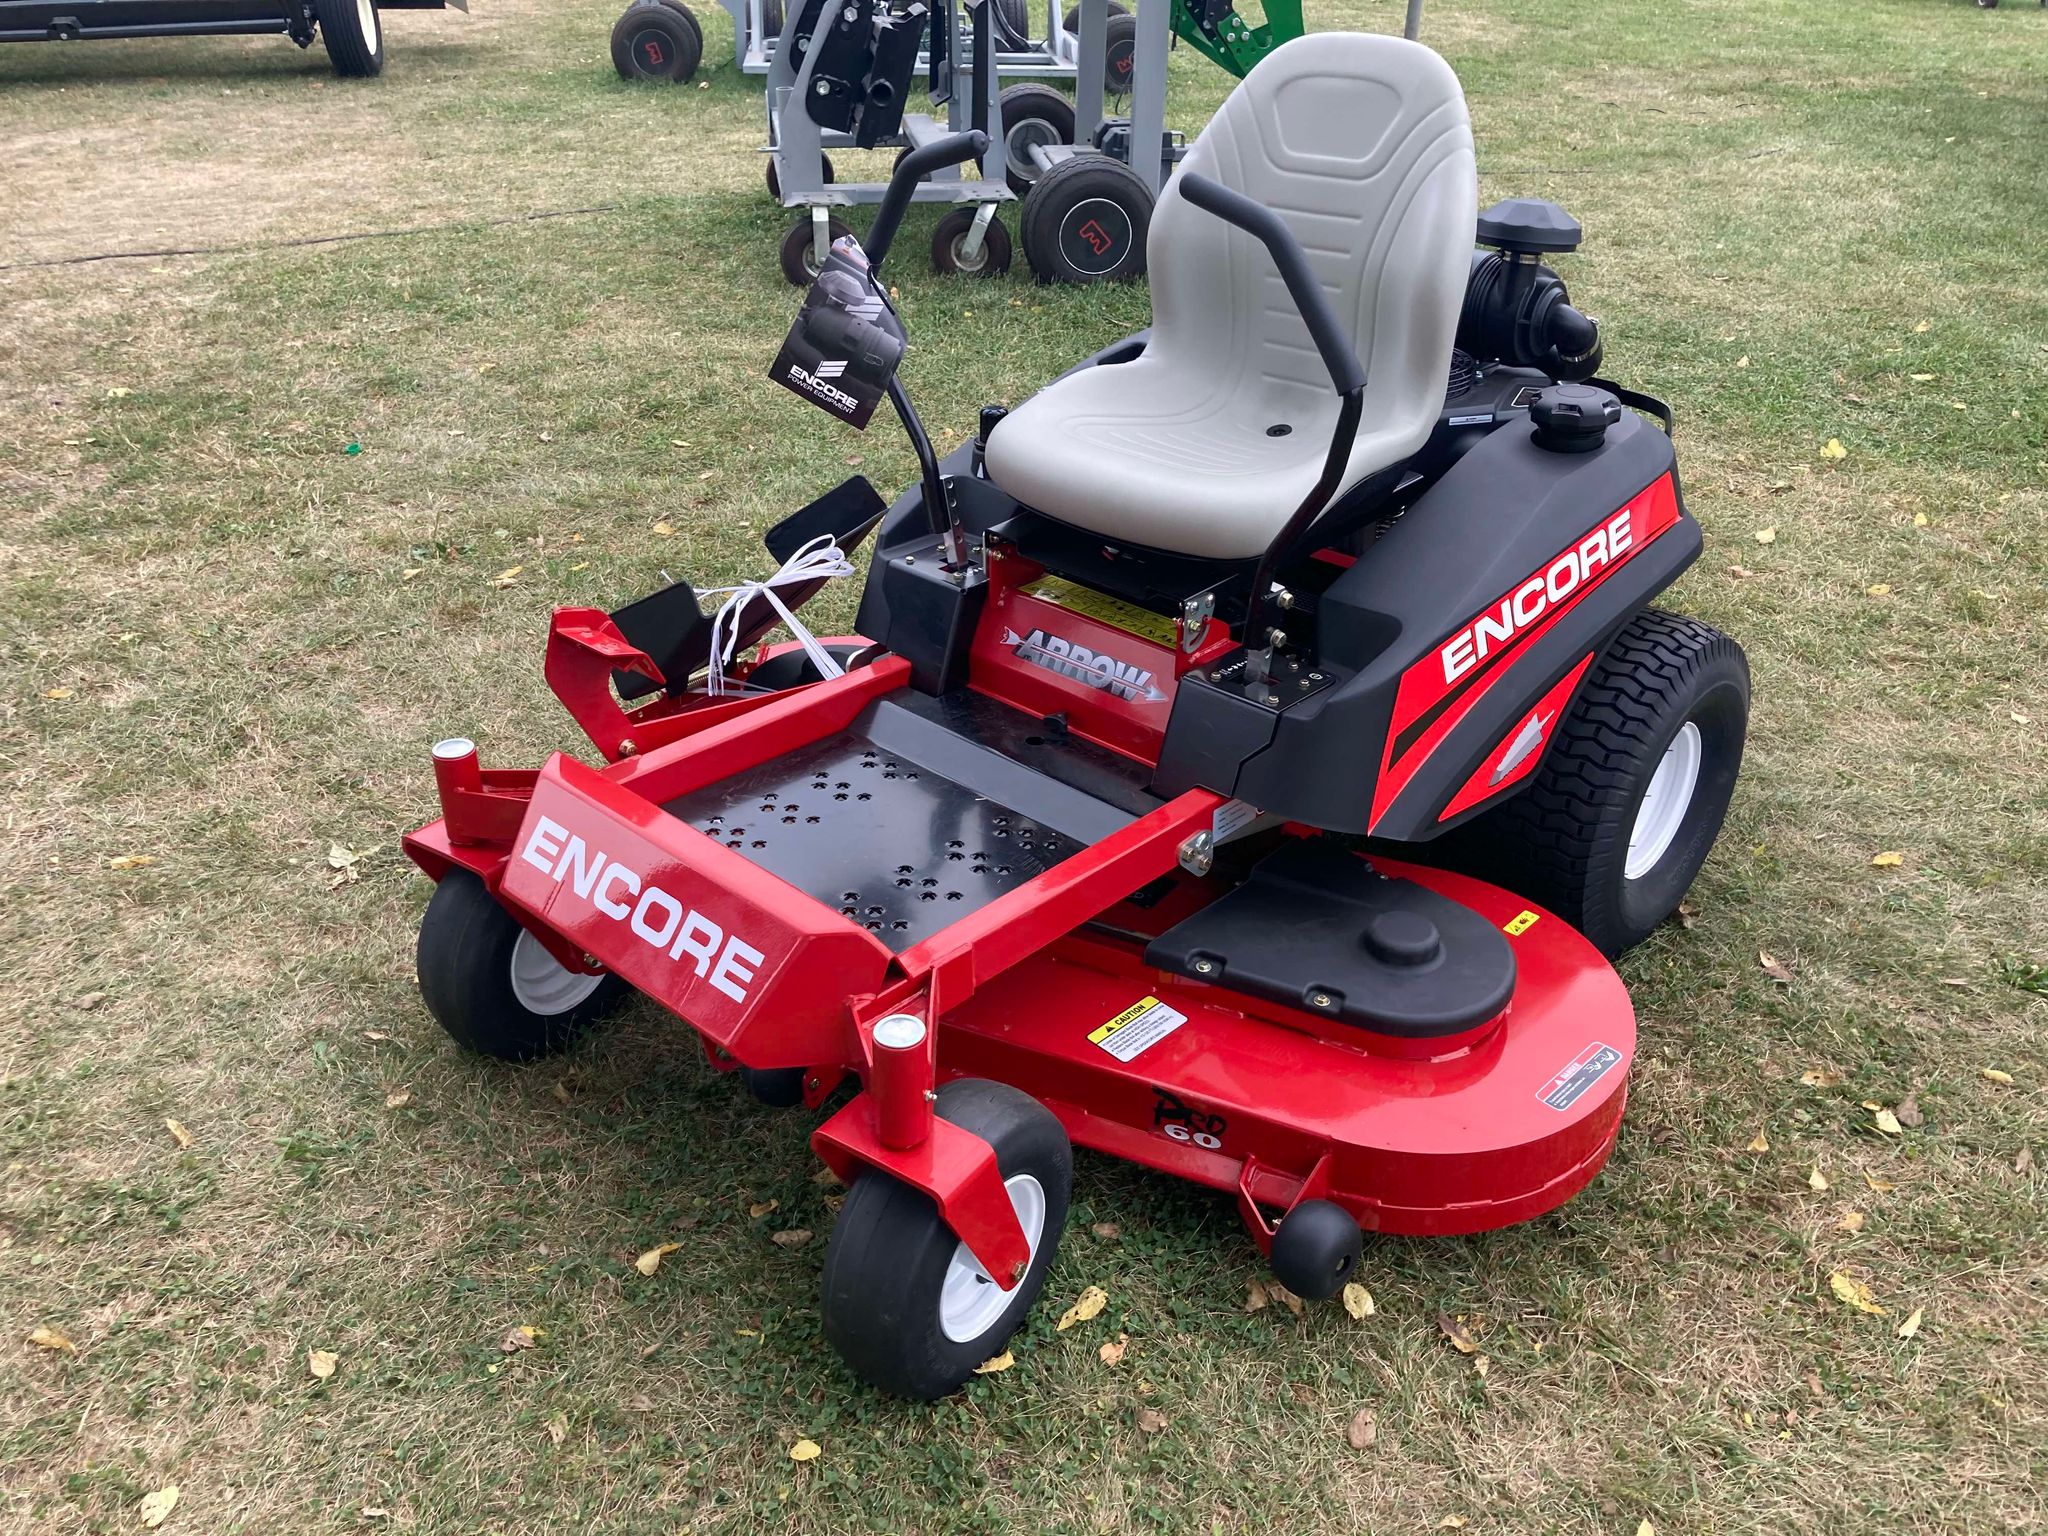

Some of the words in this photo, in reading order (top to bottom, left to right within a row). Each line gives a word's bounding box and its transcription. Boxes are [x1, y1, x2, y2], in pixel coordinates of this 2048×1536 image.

[787, 374, 813, 392] POWER
[814, 390, 854, 414] EQUIPMENT
[789, 364, 859, 410] ENCORE
[1441, 509, 1633, 685] ENCORE
[1011, 627, 1152, 701] ARROW
[521, 815, 765, 1004] ENCORE
[1114, 1004, 1146, 1026] CAUTION
[1163, 1123, 1222, 1149] 60
